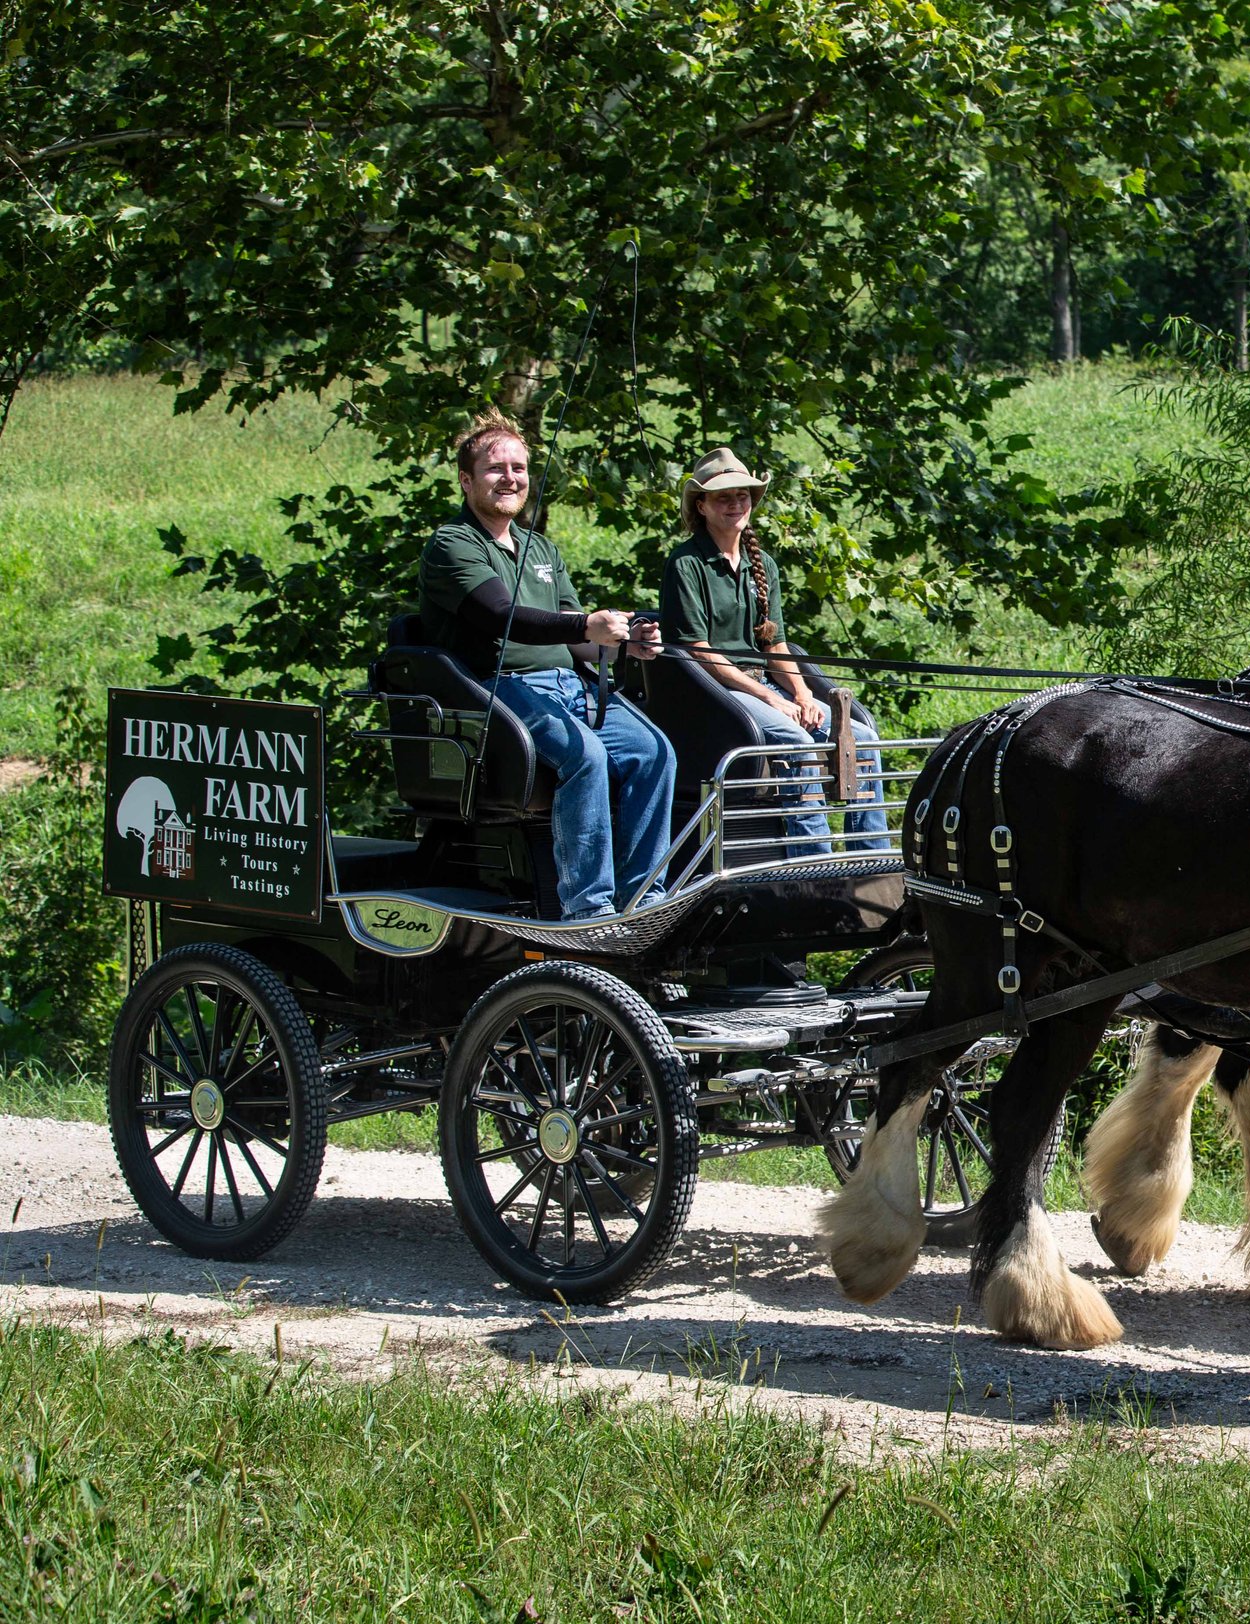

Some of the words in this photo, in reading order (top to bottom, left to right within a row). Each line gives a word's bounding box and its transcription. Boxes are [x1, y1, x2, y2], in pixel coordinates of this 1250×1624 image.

[122, 717, 308, 775] HERMANN
[203, 777, 308, 827] FARM
[204, 826, 248, 848] Living
[255, 831, 308, 854] History
[241, 854, 278, 872] Tours
[230, 874, 290, 898] Tastings
[371, 908, 432, 934] Leon
